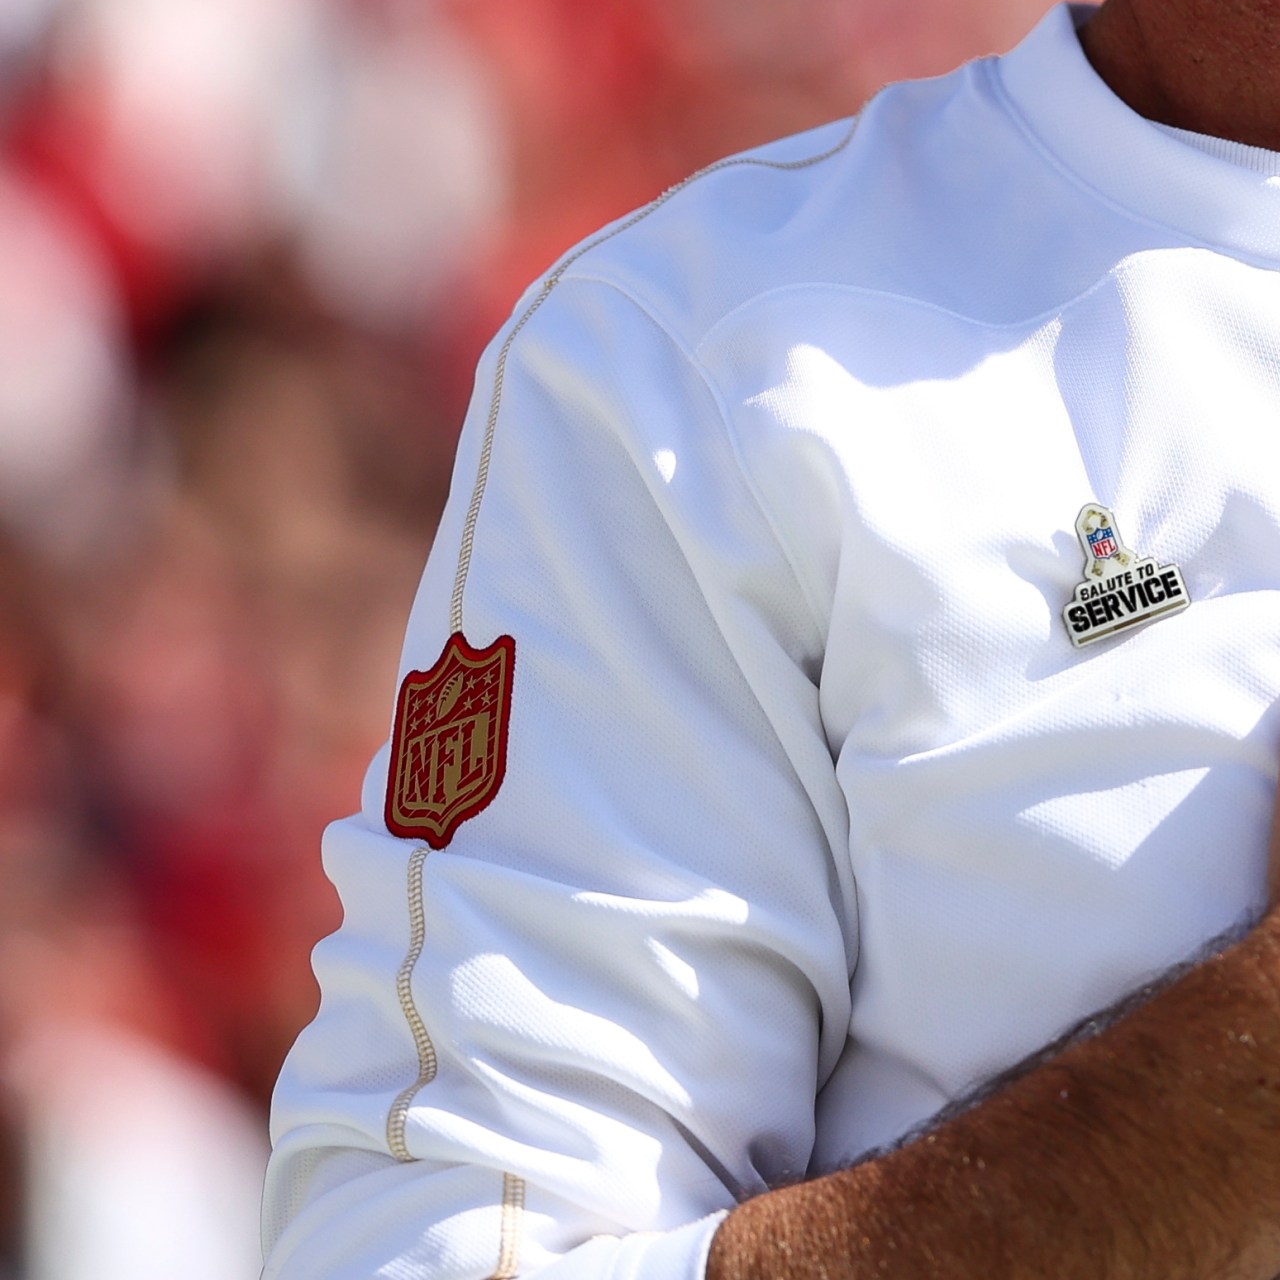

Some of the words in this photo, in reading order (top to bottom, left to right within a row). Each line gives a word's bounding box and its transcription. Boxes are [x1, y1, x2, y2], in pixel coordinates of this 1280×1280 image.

[1091, 539, 1117, 557] NFL
[1068, 570, 1182, 632] SERVICE
[1080, 571, 1133, 601] SALUTE
[1136, 563, 1154, 580] TO
[405, 718, 487, 804] NFL
